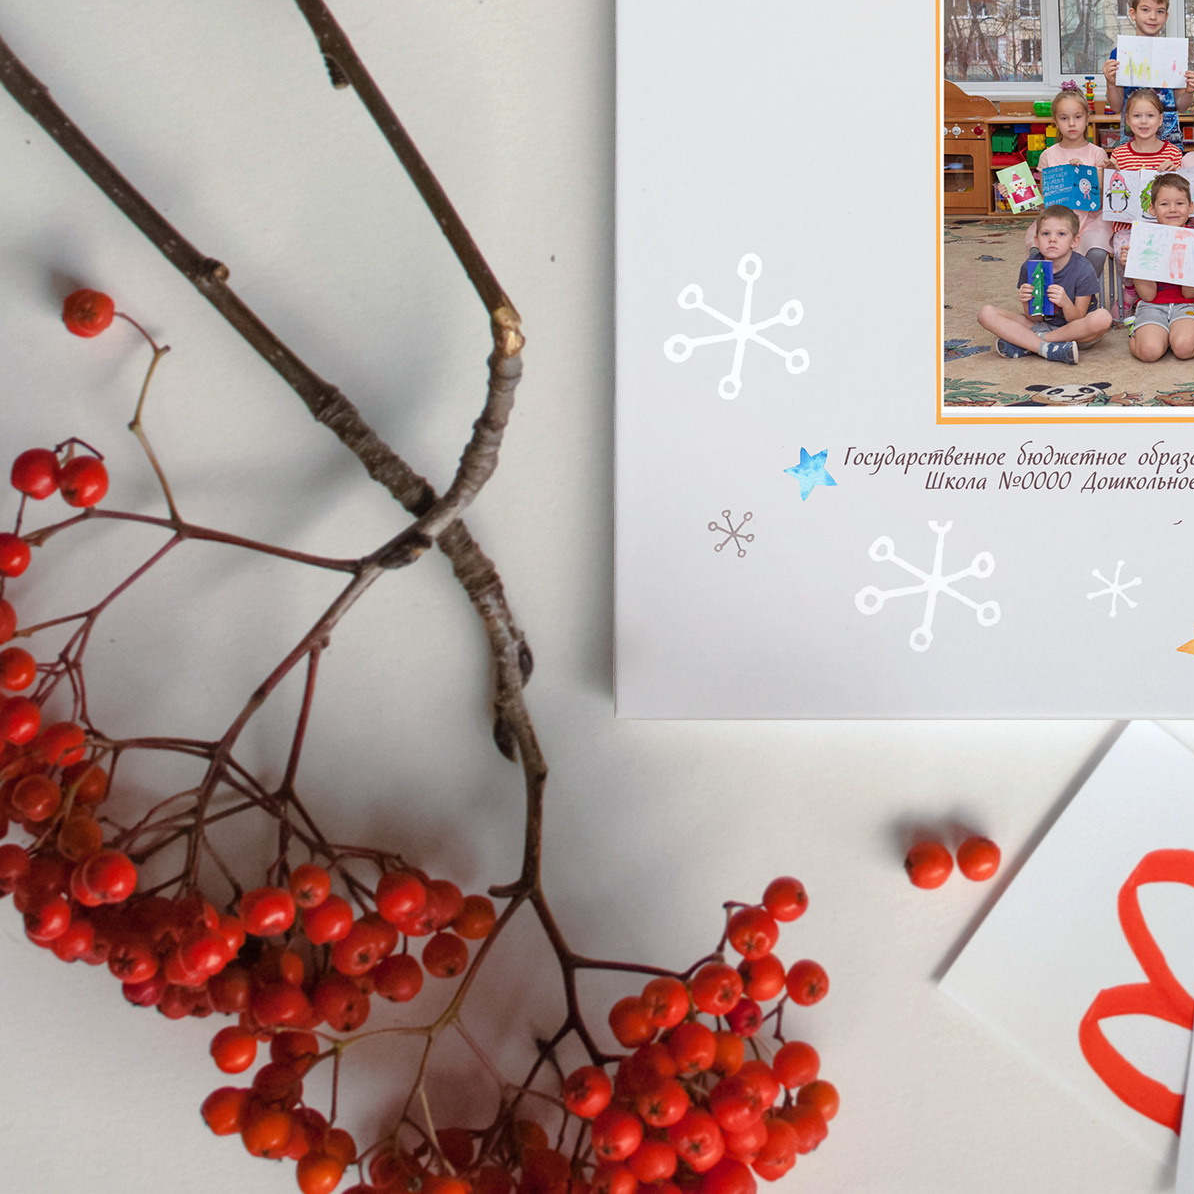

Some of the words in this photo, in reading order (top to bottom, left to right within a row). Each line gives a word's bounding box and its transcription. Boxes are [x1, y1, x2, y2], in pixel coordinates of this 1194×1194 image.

[843, 446, 1006, 476] Государственное
[1016, 440, 1127, 466] бюджетное
[925, 471, 987, 490] Школа
[998, 471, 1072, 490] №0000
